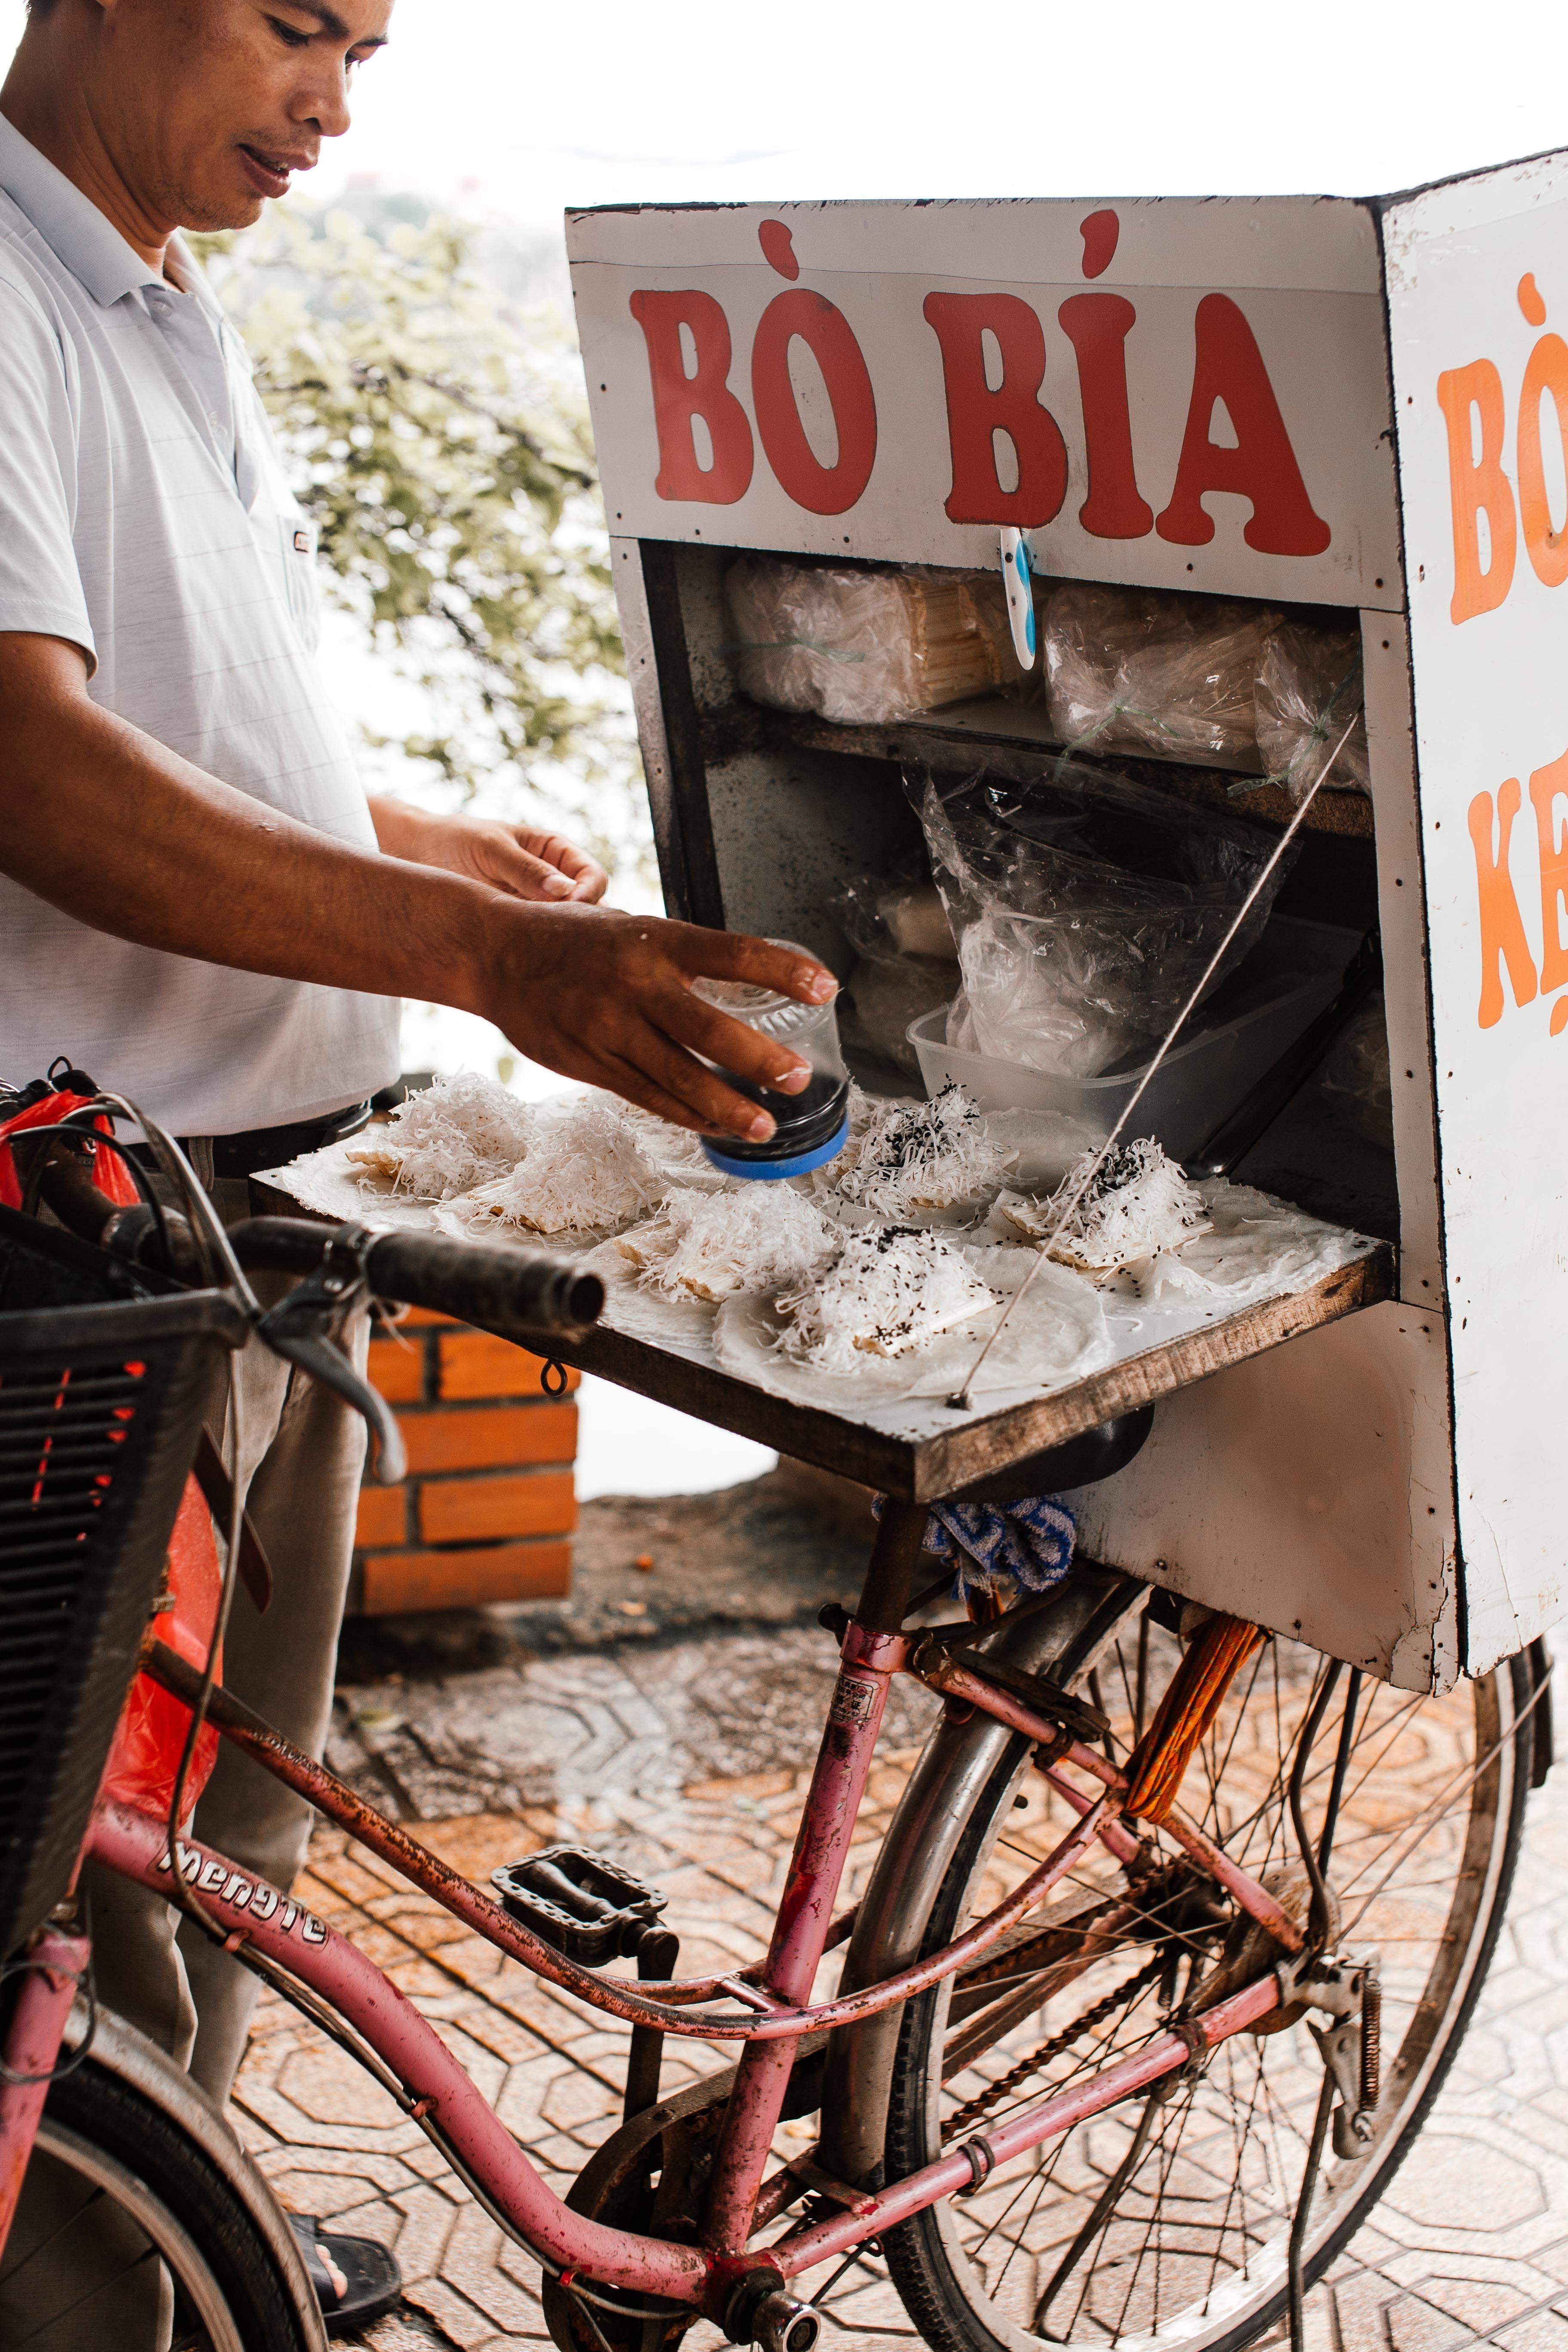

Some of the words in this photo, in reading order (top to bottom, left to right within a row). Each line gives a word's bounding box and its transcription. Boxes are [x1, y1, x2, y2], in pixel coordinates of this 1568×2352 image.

[630, 220, 876, 514] BÒ
[925, 210, 1331, 557] BÍA
[1436, 272, 1568, 626] BÒ
